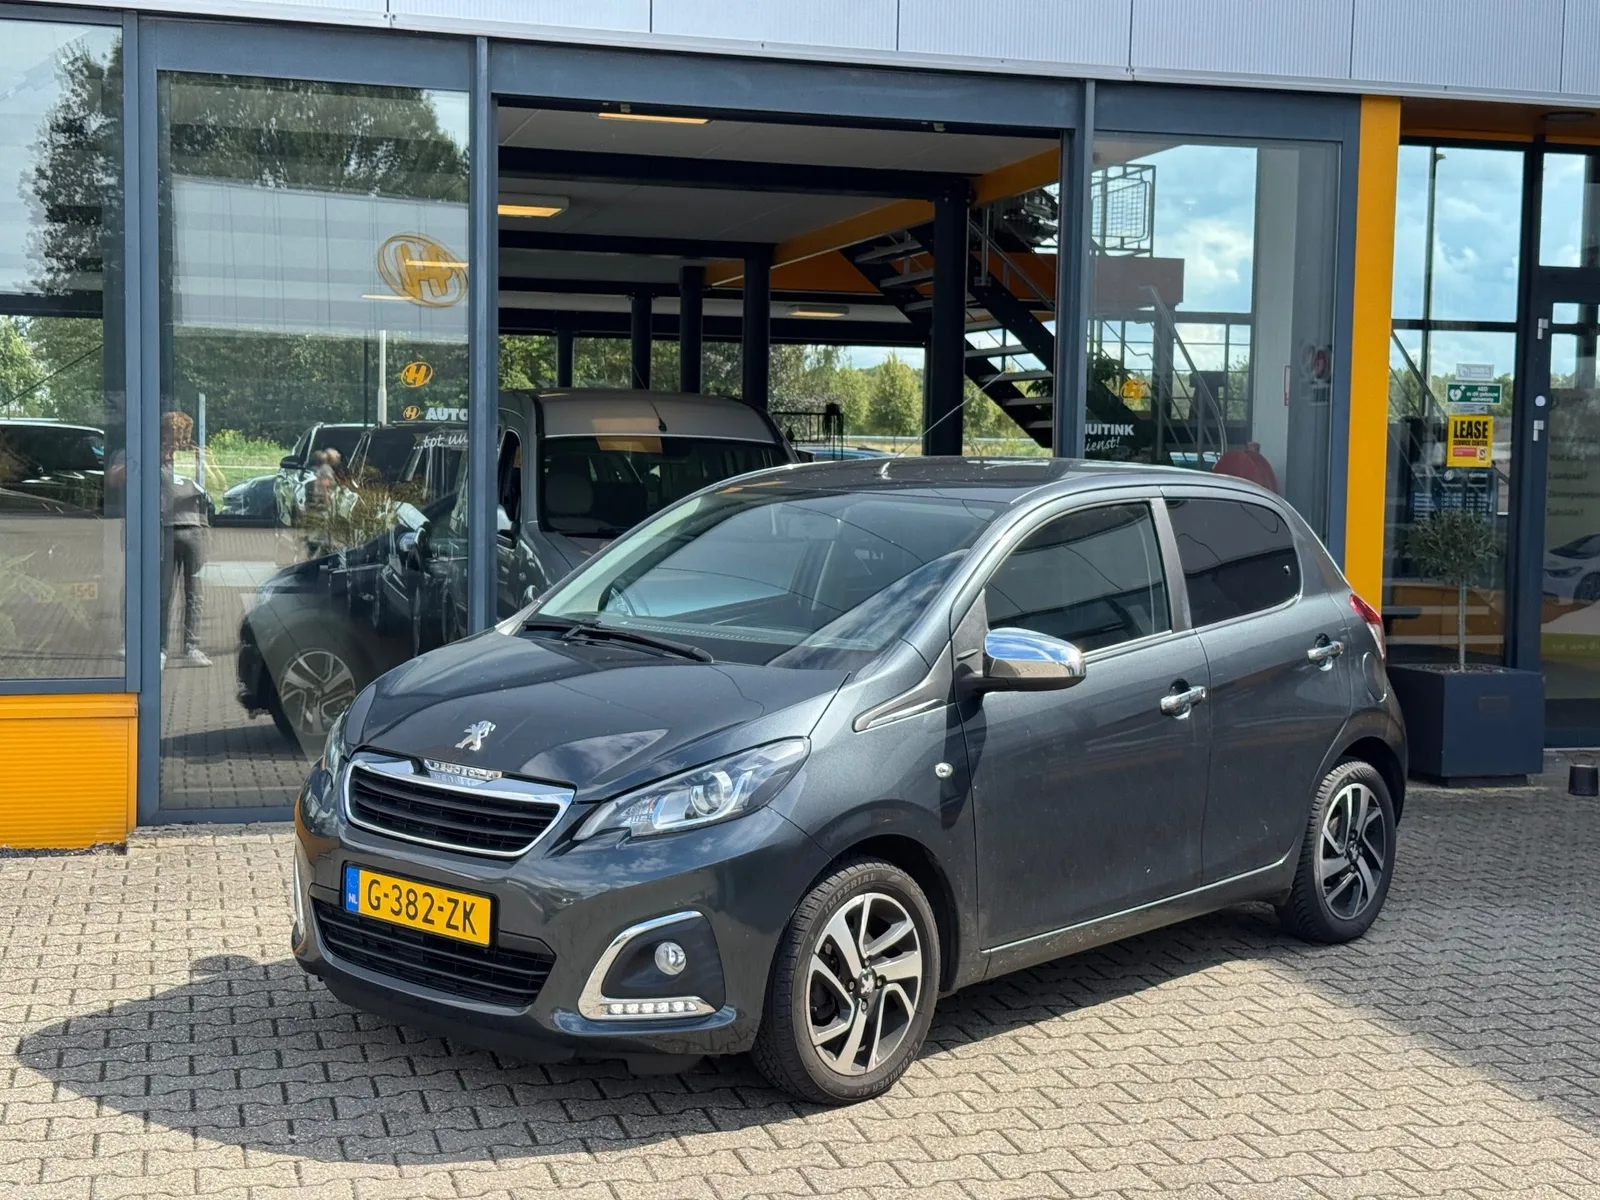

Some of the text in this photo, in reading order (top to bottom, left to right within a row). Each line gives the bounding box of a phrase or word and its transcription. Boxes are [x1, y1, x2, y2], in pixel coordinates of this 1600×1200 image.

[1085, 436, 1120, 452] ienst!
[1453, 421, 1488, 439] LEASE
[348, 878, 478, 936] NL G-382-ZK
[823, 872, 877, 914] IMPERIAL
